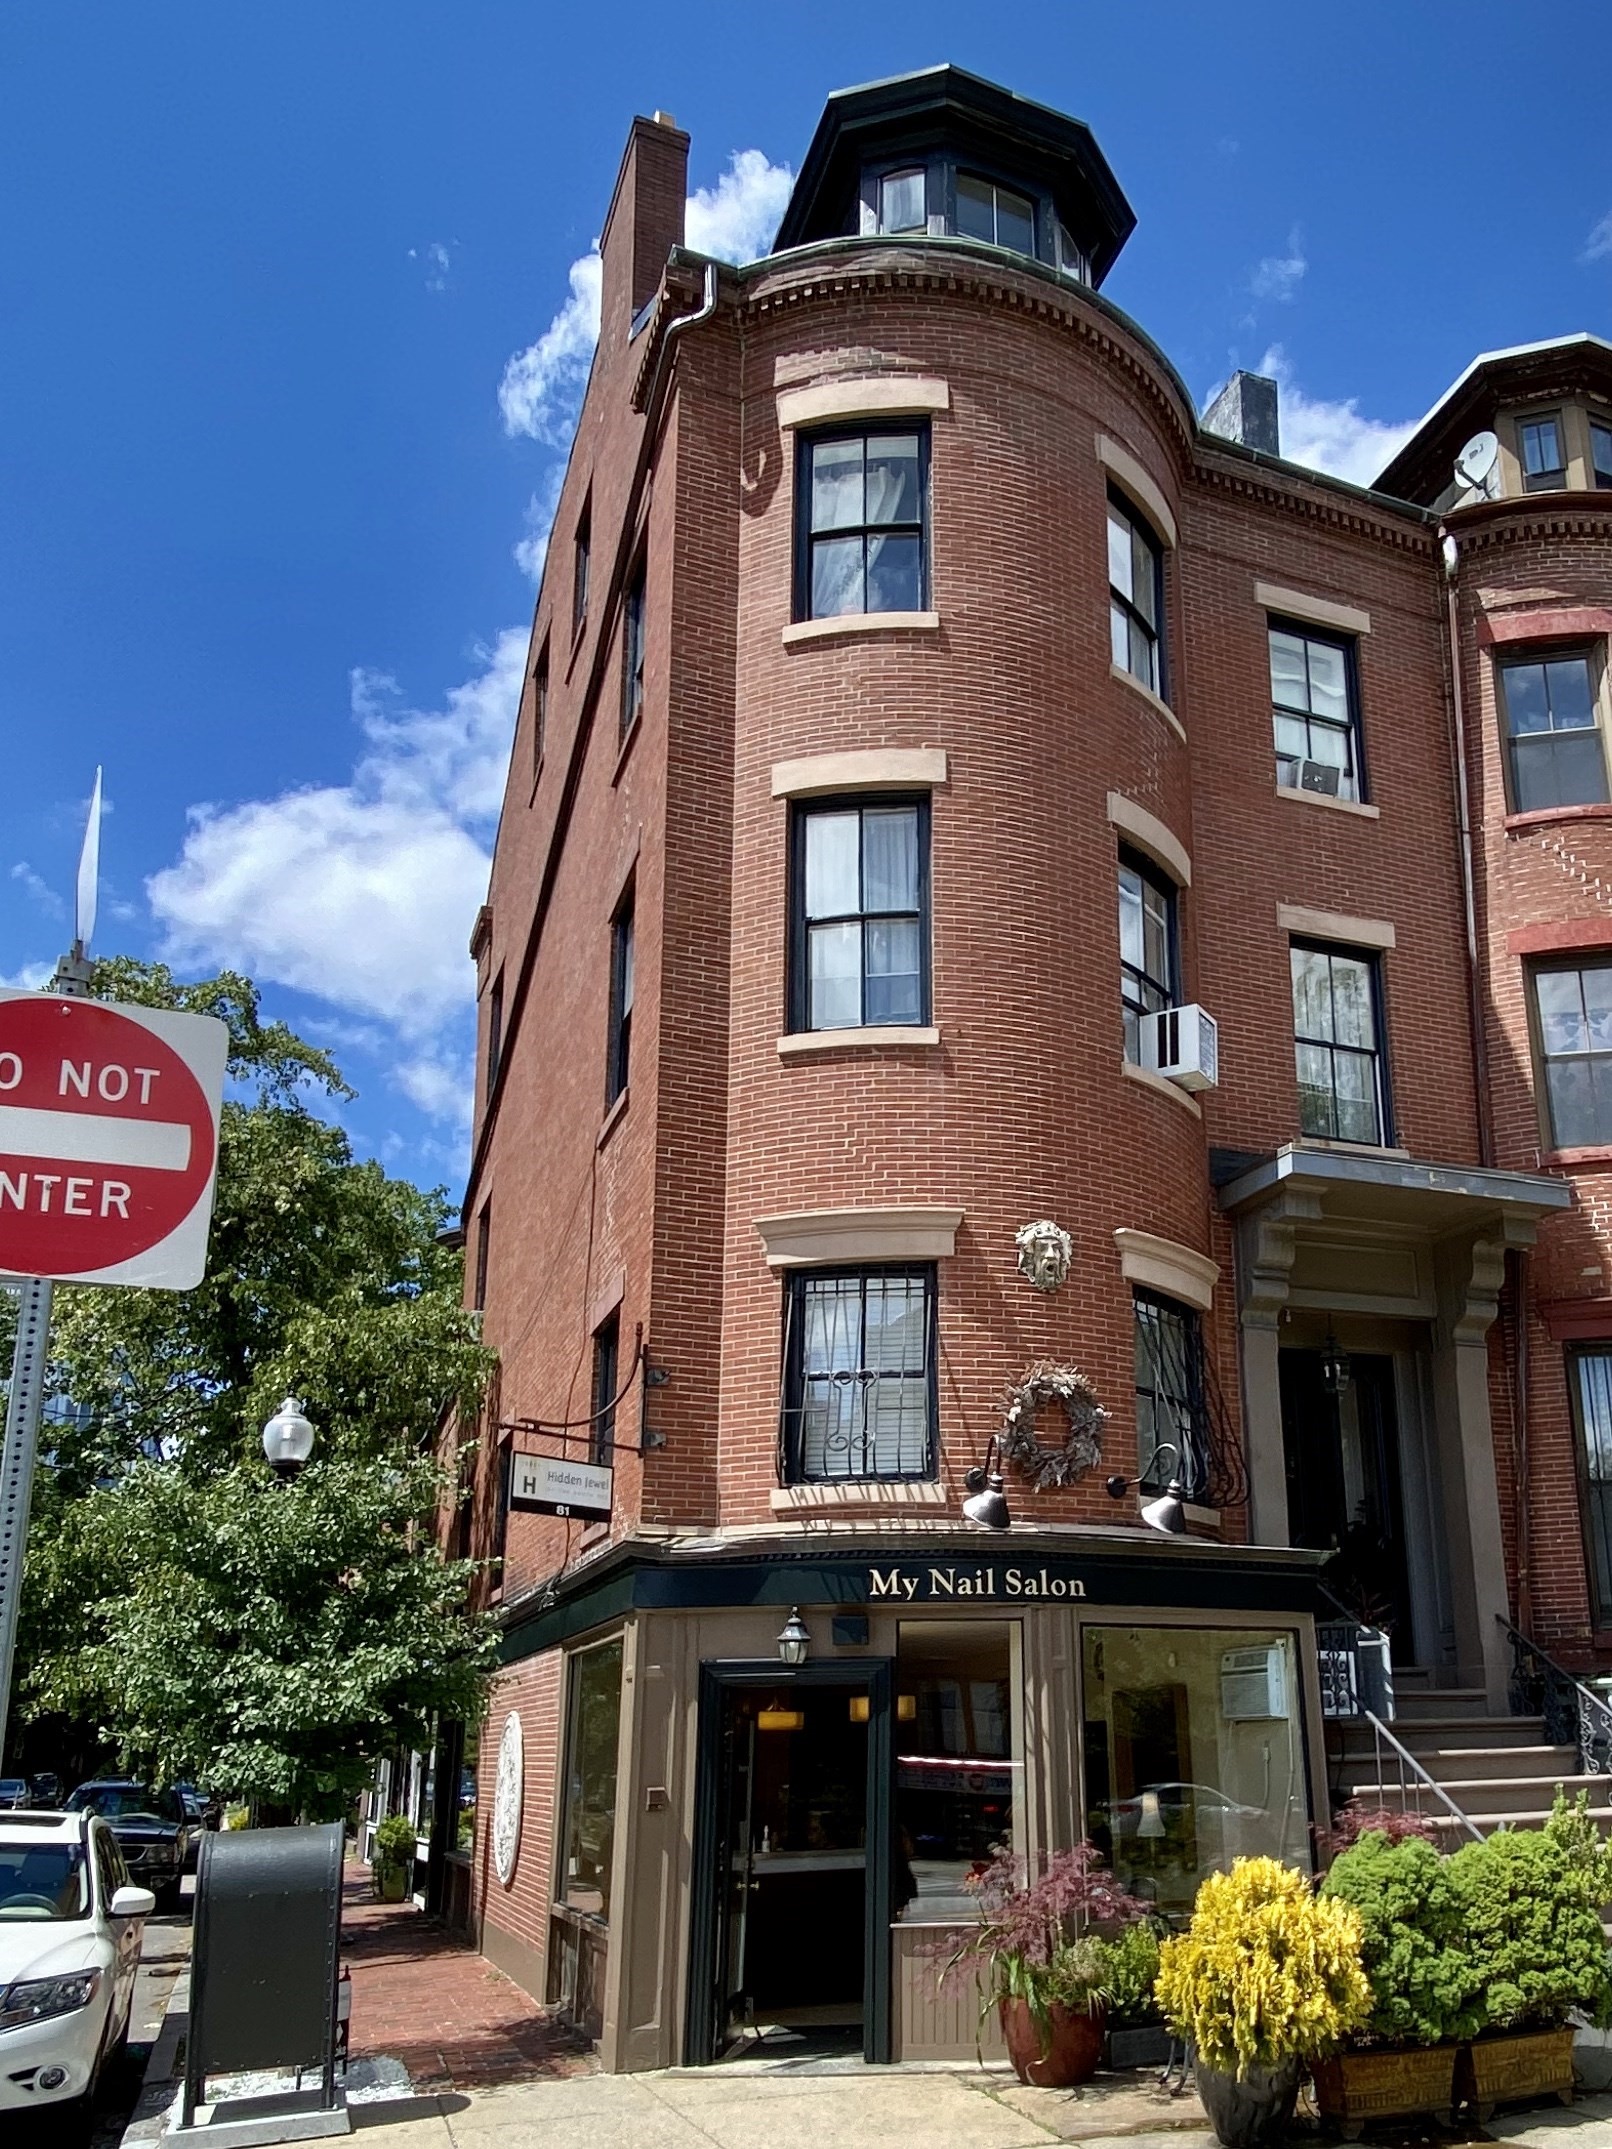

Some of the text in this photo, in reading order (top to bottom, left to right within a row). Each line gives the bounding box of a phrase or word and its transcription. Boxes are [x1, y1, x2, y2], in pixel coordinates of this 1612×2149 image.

[0, 1052, 161, 1105] O NOT
[0, 1171, 132, 1219] NTER
[547, 1471, 582, 1486] Hidden
[556, 1505, 570, 1516] 81
[869, 1568, 1087, 1600] My Nail Salon
